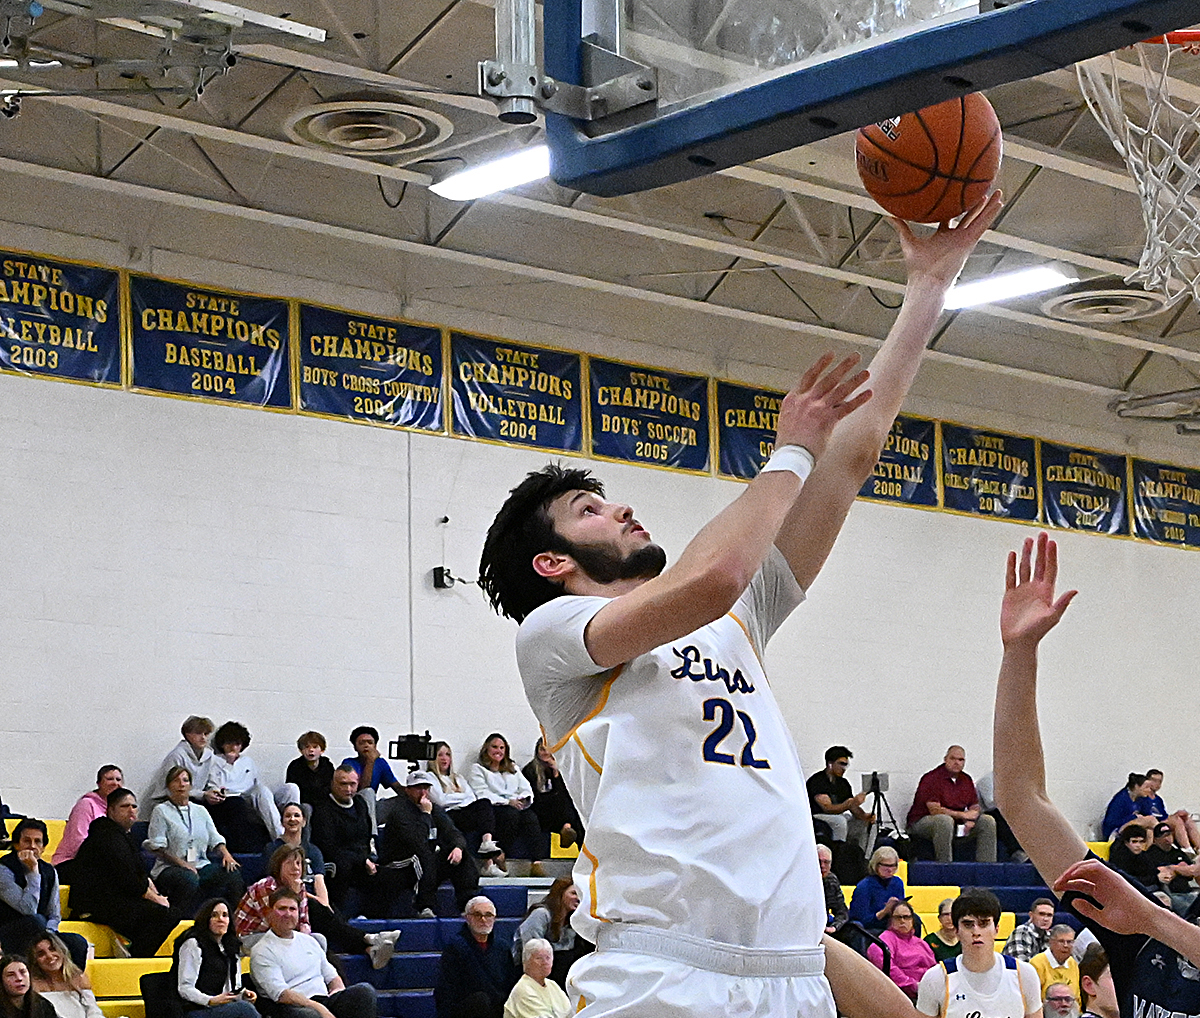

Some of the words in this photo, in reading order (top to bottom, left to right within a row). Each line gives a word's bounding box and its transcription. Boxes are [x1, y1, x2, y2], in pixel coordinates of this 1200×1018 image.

[3, 260, 64, 286] STATE
[186, 293, 240, 316] STATE
[142, 308, 281, 350] CHAMPIONS
[348, 320, 397, 343] STATE
[10, 345, 58, 369] 2003
[165, 343, 262, 376] BASEBALL
[310, 335, 433, 376] CHAMPIONS
[496, 347, 539, 369] STATE
[191, 372, 236, 395] 2004
[342, 374, 380, 396] CROSS
[384, 380, 439, 404] COUNTRY
[459, 361, 573, 400] CHAMPIONS
[630, 372, 671, 392] STATE
[354, 396, 394, 417] 2004
[468, 391, 566, 426] VOLLEYBALL
[598, 386, 700, 422] CHAMPIONS
[754, 395, 782, 411] STAT
[500, 420, 537, 441] 2004
[647, 422, 698, 447] SOCCER
[636, 441, 668, 460] 2005
[760, 441, 775, 457] GO
[973, 435, 1005, 451] STATE
[949, 448, 1029, 477] CHAMPIONS
[1069, 452, 1099, 469] STATE
[1046, 465, 1122, 491] CHAMPIONS
[1060, 491, 1112, 512] SOFTBALL
[702, 697, 772, 770] 22
